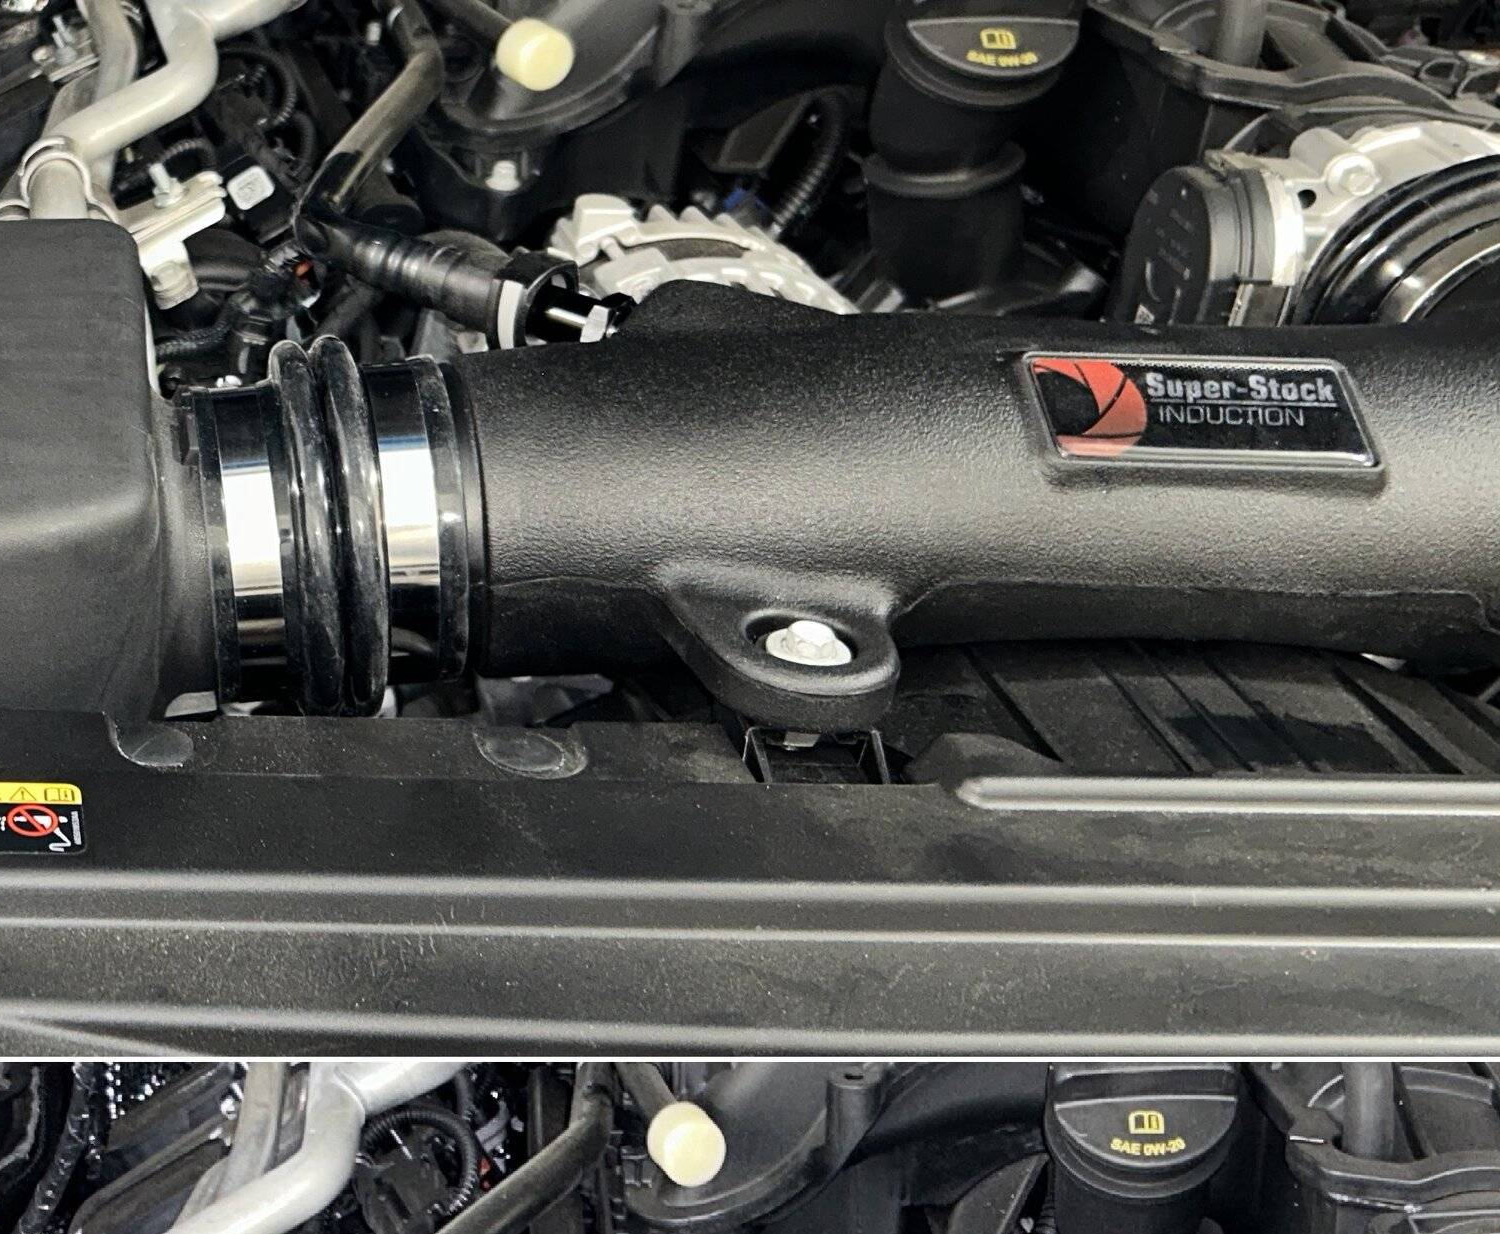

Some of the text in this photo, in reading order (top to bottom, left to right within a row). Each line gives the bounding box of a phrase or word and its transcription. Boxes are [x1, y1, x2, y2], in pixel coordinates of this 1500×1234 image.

[1145, 371, 1336, 403] Super-Stock
[1158, 404, 1305, 427] INDUCTION
[1110, 1137, 1141, 1156] SAE
